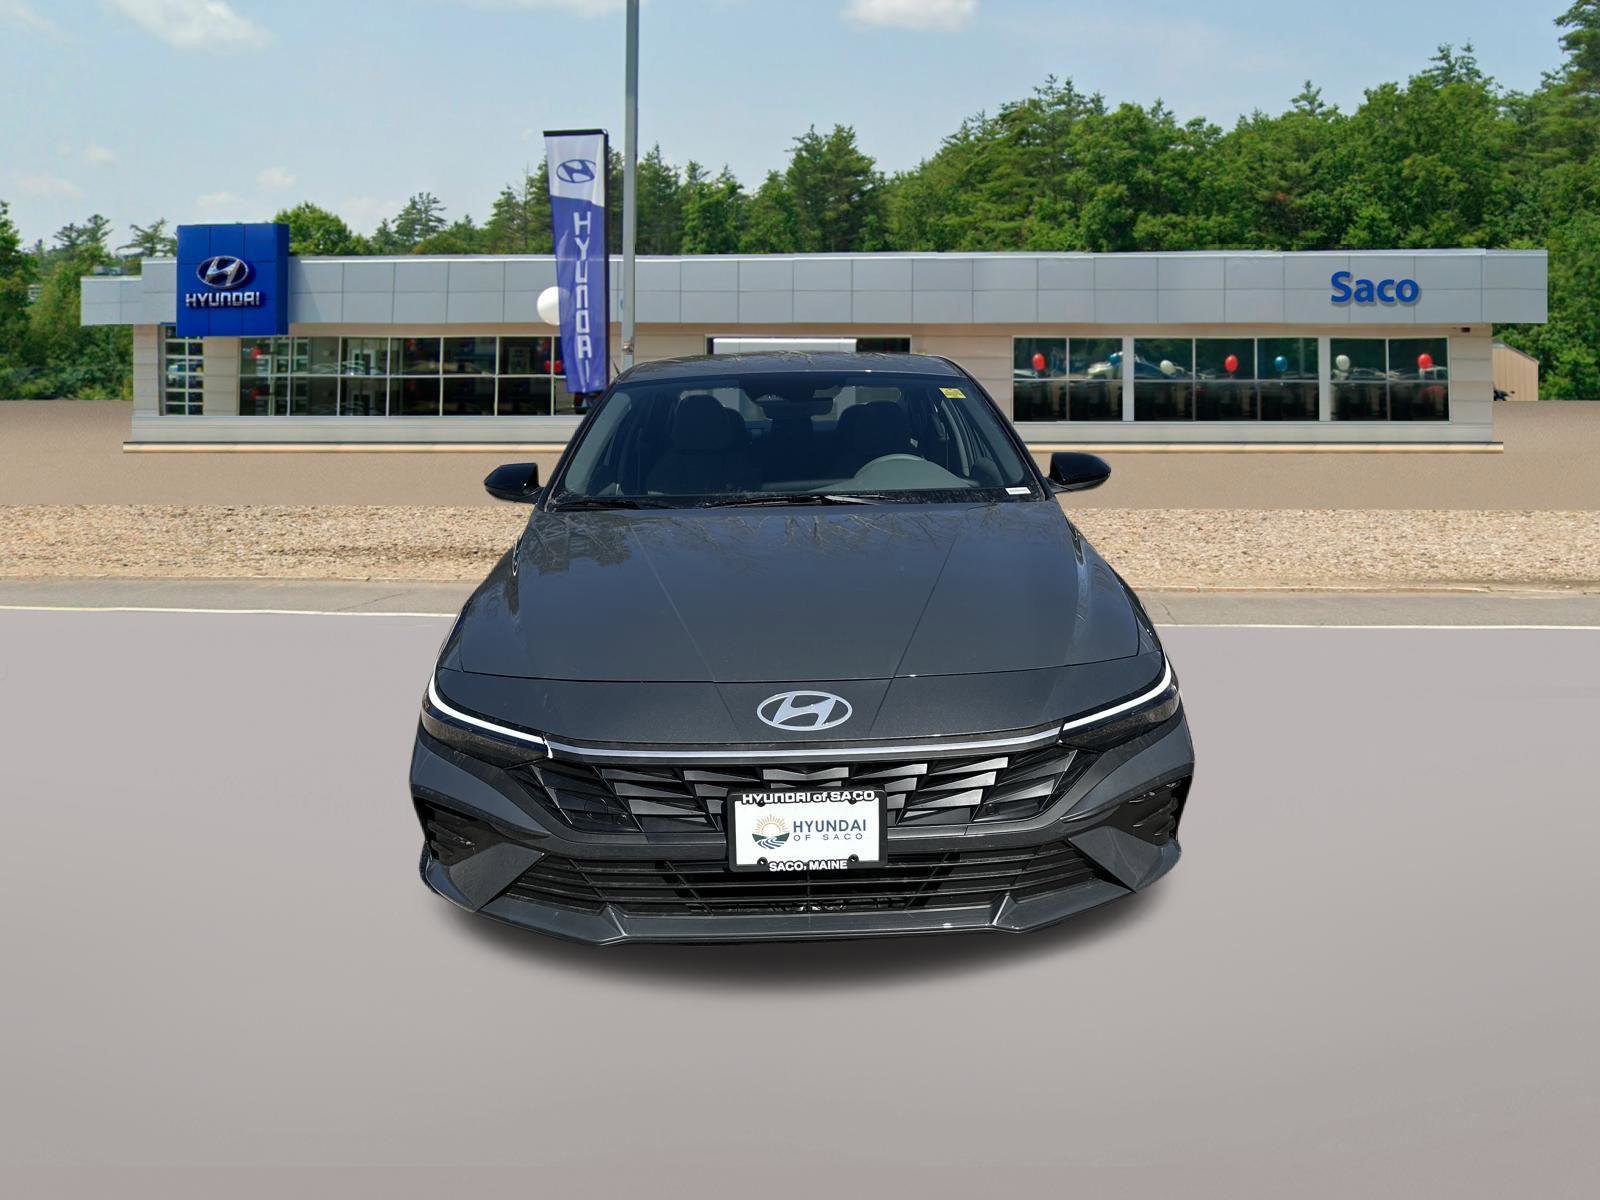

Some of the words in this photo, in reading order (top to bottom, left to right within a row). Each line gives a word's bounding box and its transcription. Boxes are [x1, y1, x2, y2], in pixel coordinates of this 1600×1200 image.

[1330, 270, 1419, 303] Saco
[185, 291, 260, 307] HYUNDAI
[573, 211, 592, 383] HYUNDAI
[742, 792, 811, 804] HYUNDAI
[812, 792, 829, 802] of
[829, 790, 875, 802] SACO
[793, 819, 867, 833] HYUNDAI
[793, 834, 812, 842] OF
[823, 833, 863, 841] SACO
[769, 861, 807, 872] SACO,
[809, 860, 848, 870] MAINE
